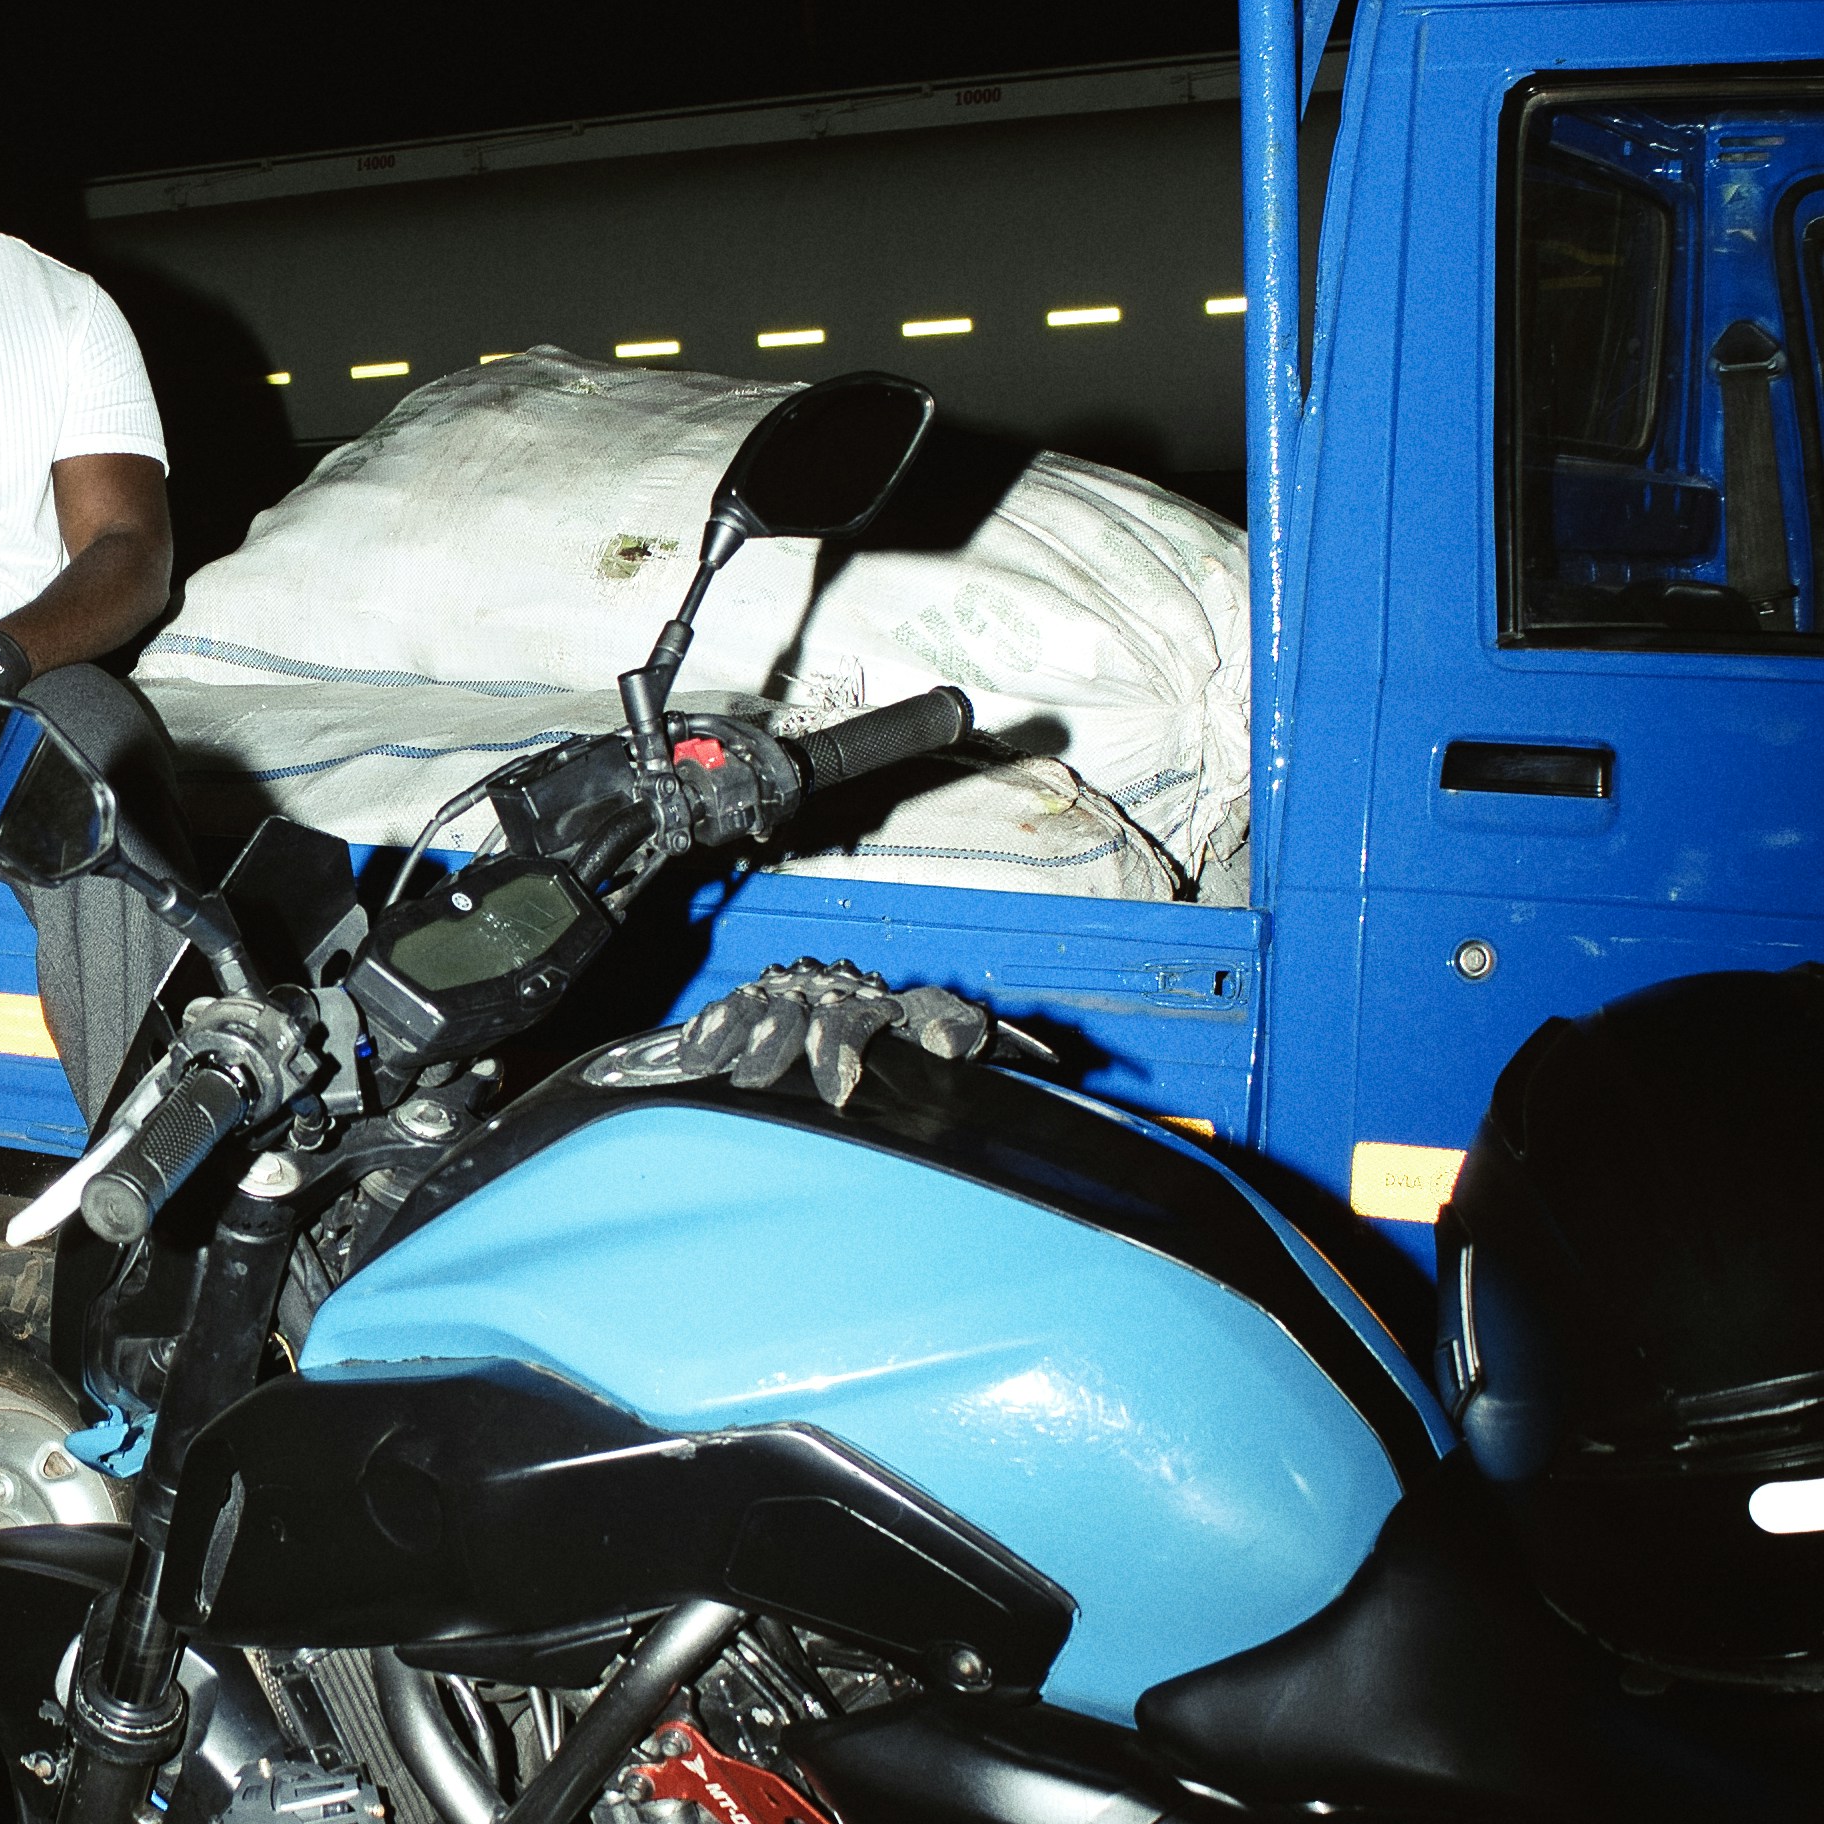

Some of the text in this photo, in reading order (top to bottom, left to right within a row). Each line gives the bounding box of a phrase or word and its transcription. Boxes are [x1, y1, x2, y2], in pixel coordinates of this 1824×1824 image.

[955, 87, 1001, 106] 10000
[356, 154, 395, 171] 14000
[1385, 1172, 1423, 1189] DVLA
